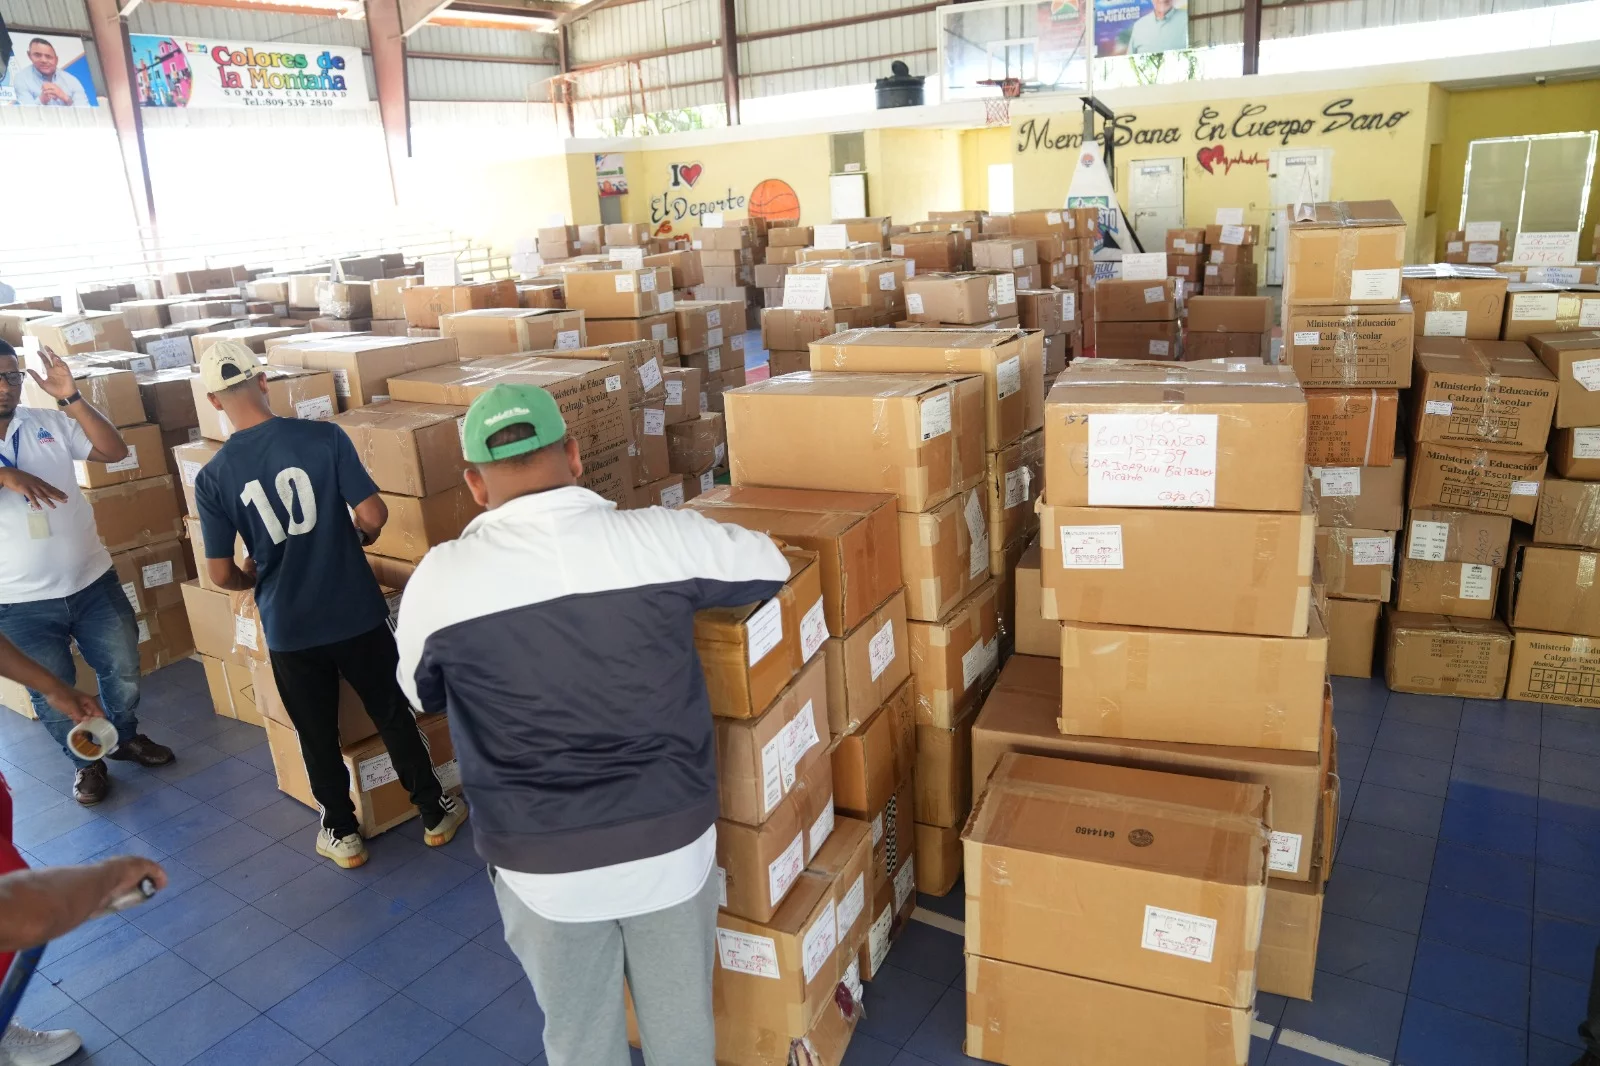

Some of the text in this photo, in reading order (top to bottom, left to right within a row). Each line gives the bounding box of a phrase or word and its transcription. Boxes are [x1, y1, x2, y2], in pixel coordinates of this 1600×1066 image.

[211, 45, 346, 70] Colores de
[218, 66, 348, 91] la Montaña
[286, 90, 348, 98] CALIDAD
[1018, 98, 1411, 152] Mene Sana En Cuerpo Sano
[671, 164, 681, 187] I
[650, 188, 746, 226] El Deporte
[1356, 318, 1396, 327] Educación
[1433, 381, 1482, 392] Ministerio
[1499, 385, 1549, 398] Educación
[586, 392, 609, 405] Escolar
[1448, 393, 1488, 404] Calzado
[1136, 417, 1192, 435] 0602
[1128, 448, 1188, 464] 15759
[1426, 450, 1472, 464] Ministerio
[1489, 459, 1538, 471] Educación
[1440, 464, 1523, 481] Calzado Escolar
[240, 466, 318, 546] 10
[1528, 642, 1572, 652] Ministerio
[1532, 660, 1554, 668] Modelo
[1544, 653, 1578, 662] Calzado
[1075, 826, 1115, 838] 6414460
